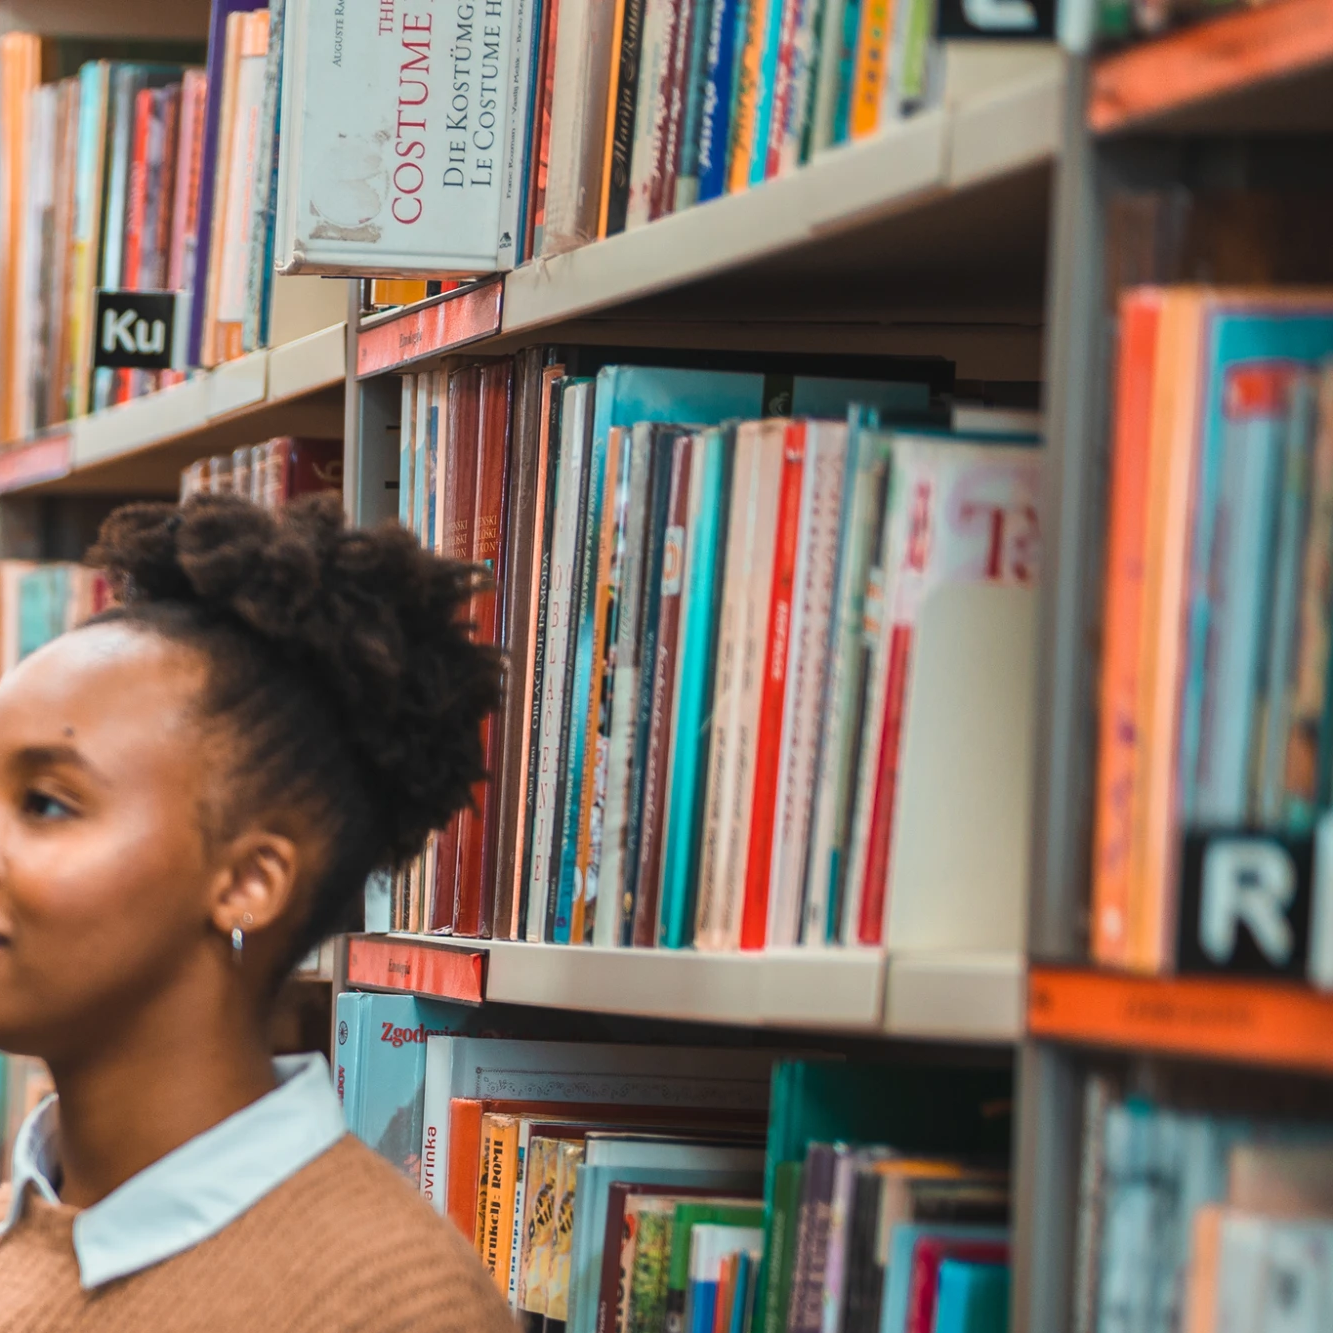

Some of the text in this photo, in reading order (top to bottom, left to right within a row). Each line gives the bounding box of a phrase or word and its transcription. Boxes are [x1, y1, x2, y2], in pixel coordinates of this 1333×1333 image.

[332, 19, 345, 67] AUGUSTE
[443, 0, 475, 188] DIE KOSTÜMG
[473, 26, 501, 151] COSTUME
[391, 12, 433, 224] COSTUME
[612, 87, 634, 187] Marija
[471, 158, 494, 187] LE
[507, 128, 517, 169] Rozman
[505, 171, 514, 199] Franc
[103, 309, 166, 355] Ku
[541, 550, 551, 603] MODA
[538, 609, 547, 628] IN
[532, 632, 546, 729] OBLAČENJE
[1198, 839, 1294, 966] R
[423, 1126, 437, 1203] avrinka
[491, 1138, 505, 1188] ROMI
